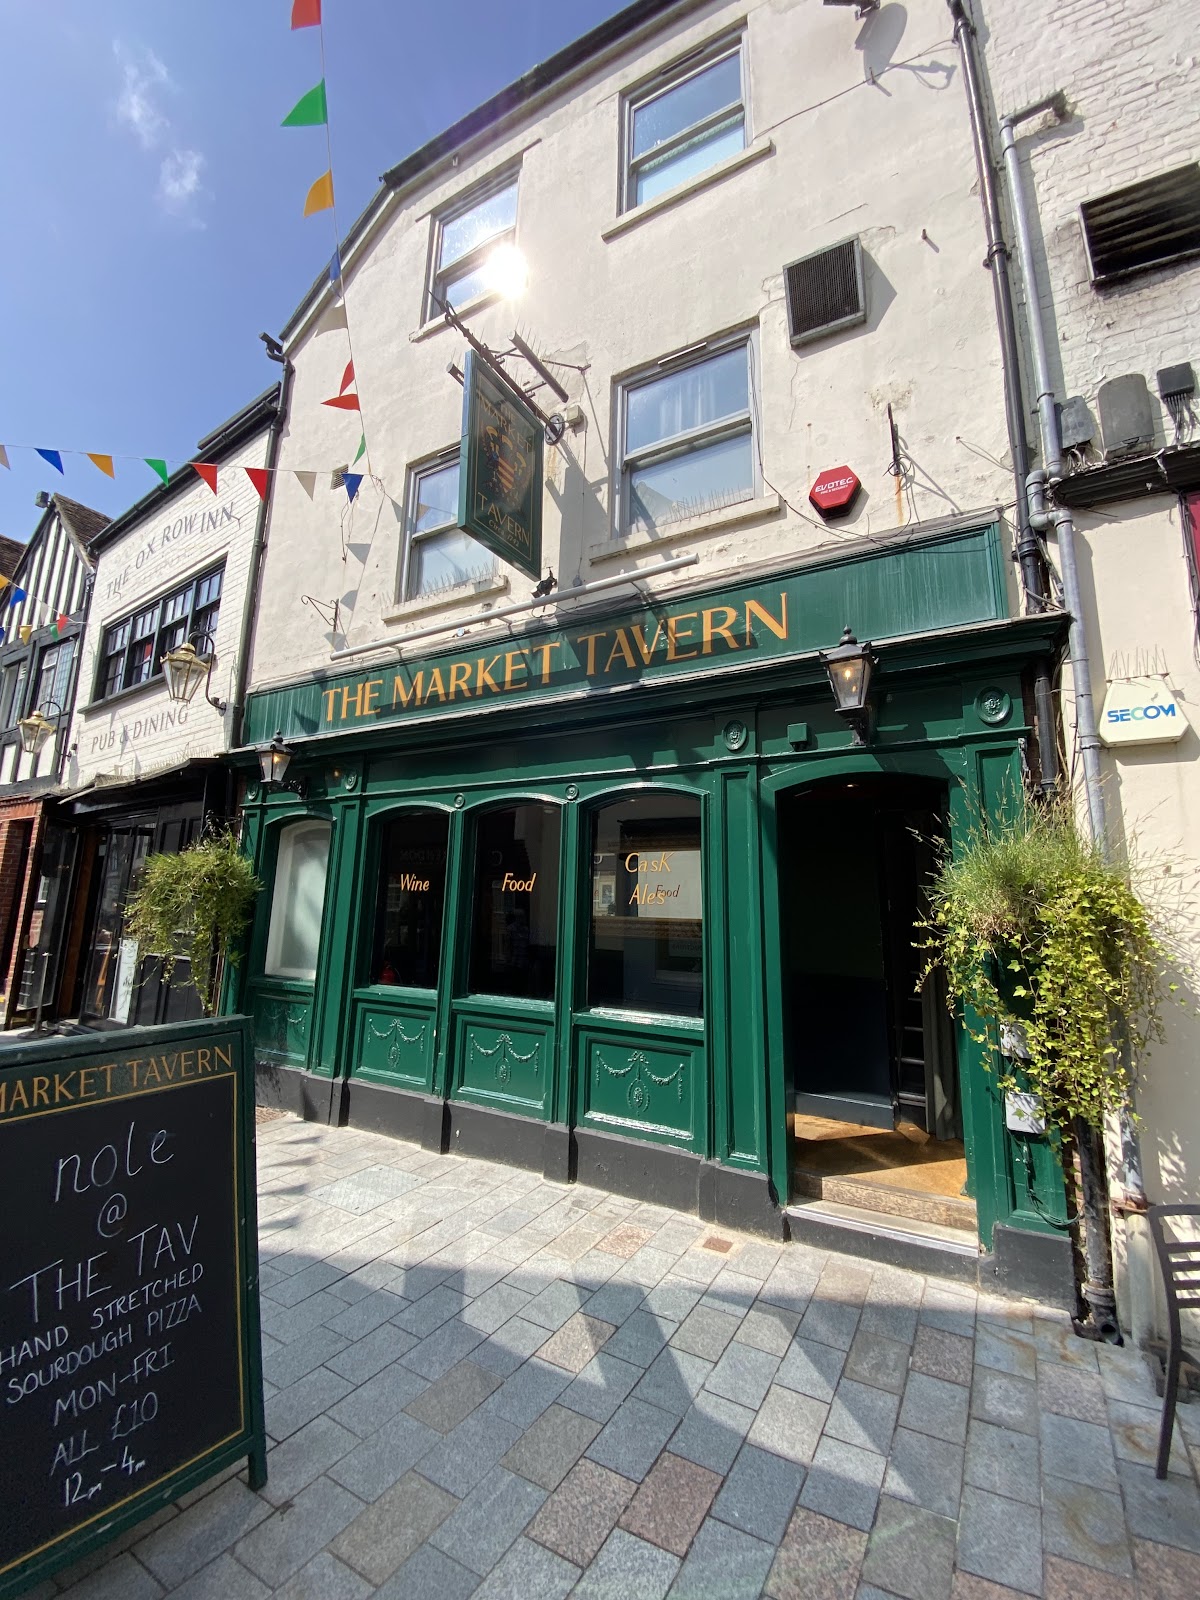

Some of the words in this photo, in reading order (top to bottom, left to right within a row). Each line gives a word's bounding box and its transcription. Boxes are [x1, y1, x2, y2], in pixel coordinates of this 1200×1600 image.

[476, 389, 533, 454] MARKET
[815, 477, 853, 493] EVOTEC
[477, 491, 530, 547] TAVERN
[107, 565, 131, 600] THE
[135, 537, 156, 570] OX
[161, 513, 198, 547] ROW
[200, 502, 235, 533] INN
[322, 678, 384, 722] THE
[392, 642, 560, 711] MARKET
[577, 592, 788, 676] TAVERN
[91, 730, 116, 754] PUB
[133, 704, 189, 739] DINING
[1107, 704, 1176, 723] SECOM
[400, 873, 430, 892] Wine
[502, 872, 537, 893] Food
[629, 883, 666, 905] Ales
[126, 1043, 233, 1088] TAVERN
[97, 1192, 128, 1238] @
[9, 1251, 112, 1323] THE
[127, 1214, 199, 1276] TAV
[0, 1325, 69, 1374] HAND
[90, 1262, 204, 1330] STRETCHED
[6, 1323, 133, 1404] SOURDOUGH
[147, 1293, 203, 1336] PIZZA
[53, 1341, 176, 1427] MON-FRI
[50, 1429, 100, 1477] ALL
[112, 1391, 159, 1440] £10
